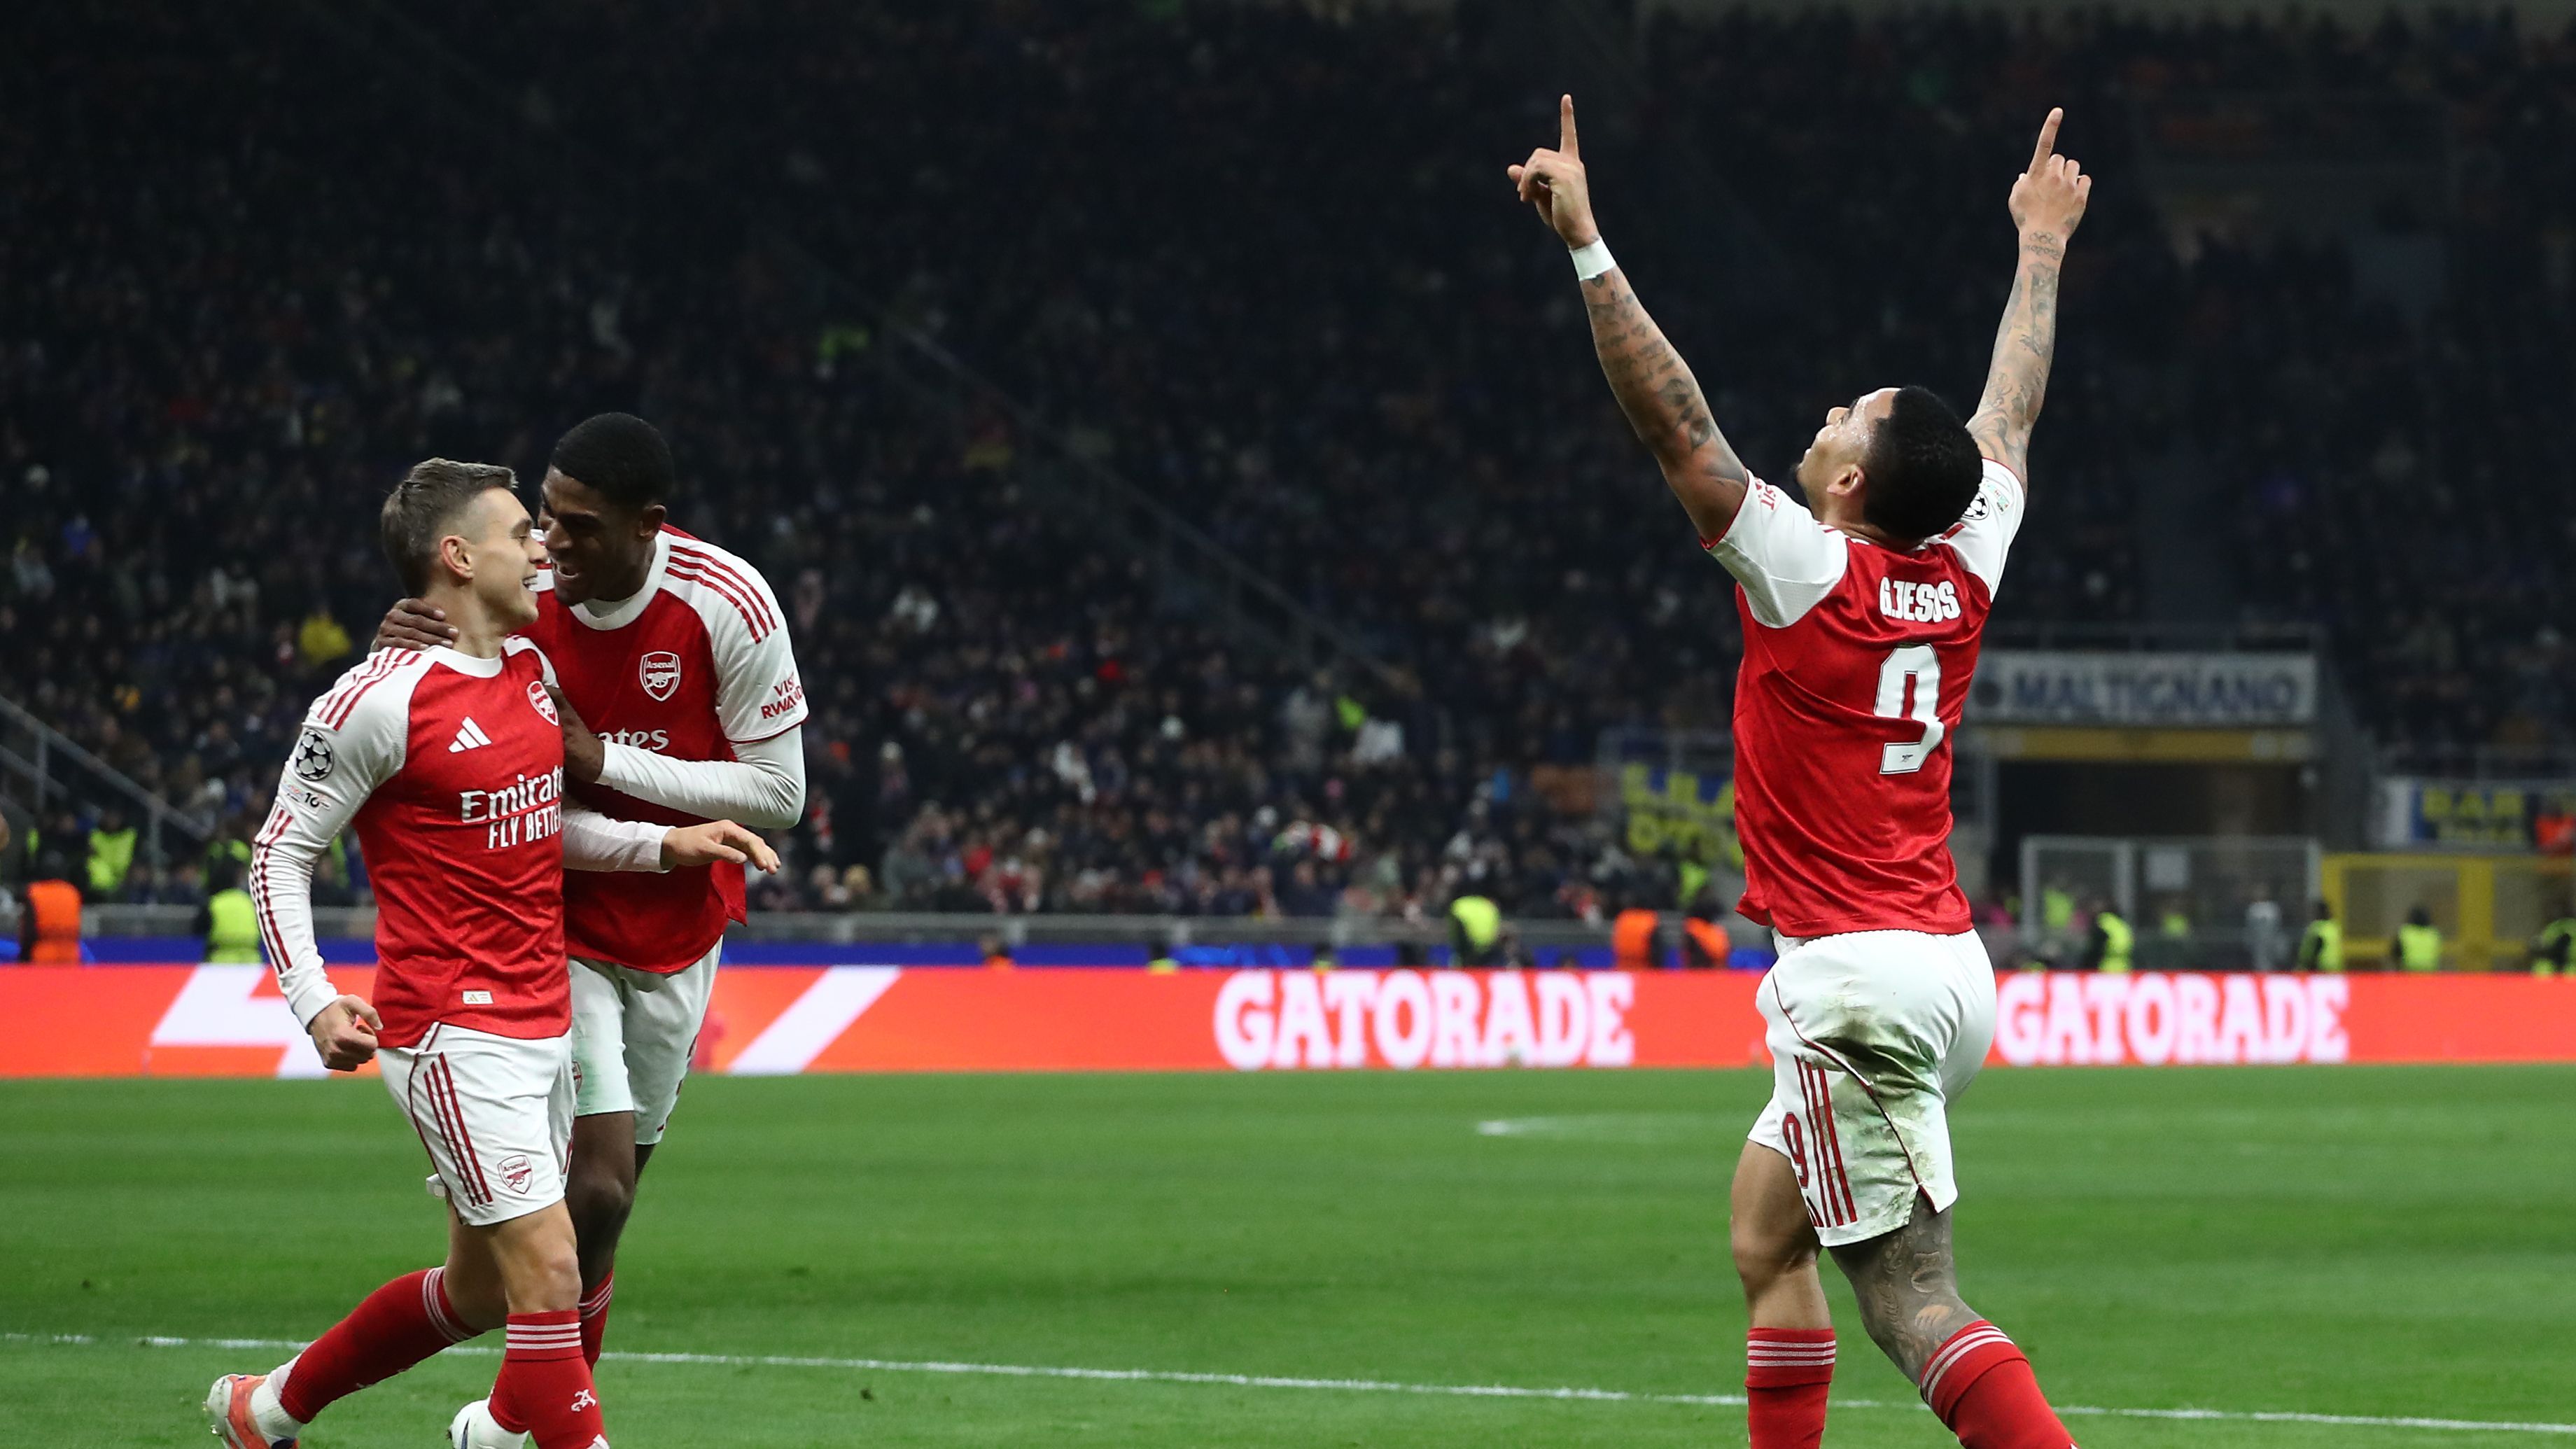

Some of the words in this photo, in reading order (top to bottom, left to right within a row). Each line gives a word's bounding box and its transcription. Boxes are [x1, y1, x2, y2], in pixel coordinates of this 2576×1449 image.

[593, 727, 670, 750] ates
[1872, 642, 1945, 775] 9
[488, 816, 520, 849] FLY
[1213, 969, 1635, 1071] GATORADE
[1996, 972, 2350, 1067] GATORADE
[1782, 1112, 1809, 1189] 9
